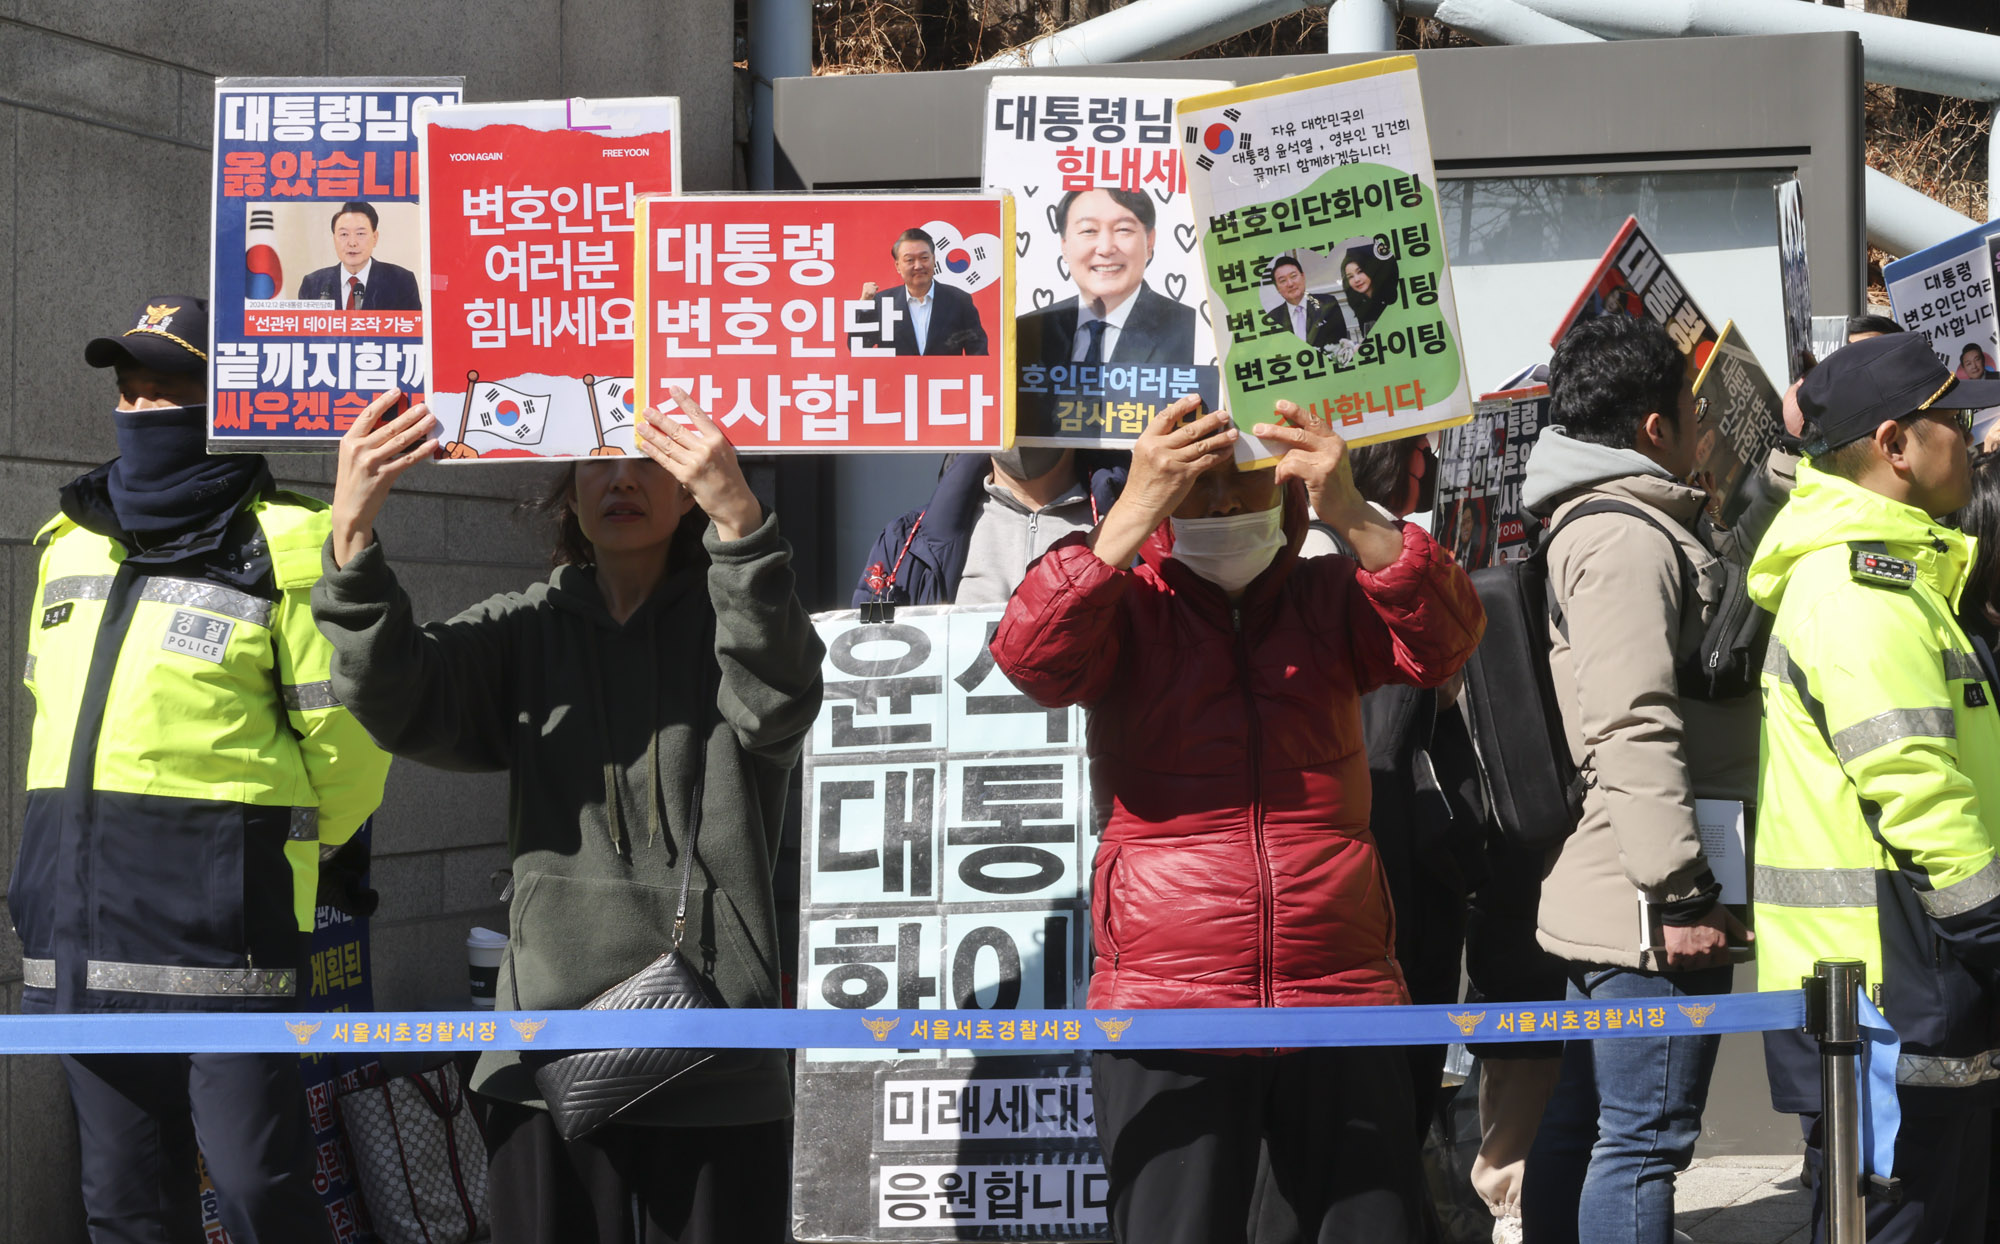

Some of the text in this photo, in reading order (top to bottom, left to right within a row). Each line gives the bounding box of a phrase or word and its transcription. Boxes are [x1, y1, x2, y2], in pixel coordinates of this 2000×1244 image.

[995, 96, 1173, 144] 대통령님
[1232, 146, 1270, 165] 대통령
[1275, 138, 1313, 159] 윤석열
[1329, 127, 1367, 147] 영부인
[1372, 119, 1410, 139] 김건희
[1271, 108, 1365, 137] 자유 대한민국의
[450, 152, 503, 162] YOON AGAIN
[602, 148, 650, 158] FREE YOON
[1055, 146, 1187, 194] 힘내세
[1253, 143, 1391, 183] 끝까지 함께하겠습니다!
[463, 182, 635, 236] 변호인단
[1209, 173, 1423, 245] 변호인단화이팅
[485, 240, 620, 292] 여러분
[656, 223, 836, 286] 대통령
[1924, 261, 1972, 291] 대통령
[1617, 235, 1707, 355] 대통령
[303, 316, 347, 332] 데이터
[350, 315, 381, 333] 조작
[464, 296, 635, 348] 힘내세요
[656, 297, 904, 358] 변호인단
[1274, 379, 1427, 430] 사합니다
[168, 636, 219, 657] POLICE
[176, 613, 226, 642] 경찰
[310, 941, 362, 997] 계획된
[331, 1021, 497, 1043] 서울서초경찰서장
[910, 1019, 1082, 1040] 서울서초경찰서장
[1496, 1006, 1666, 1033] 서울서초경찰서장
